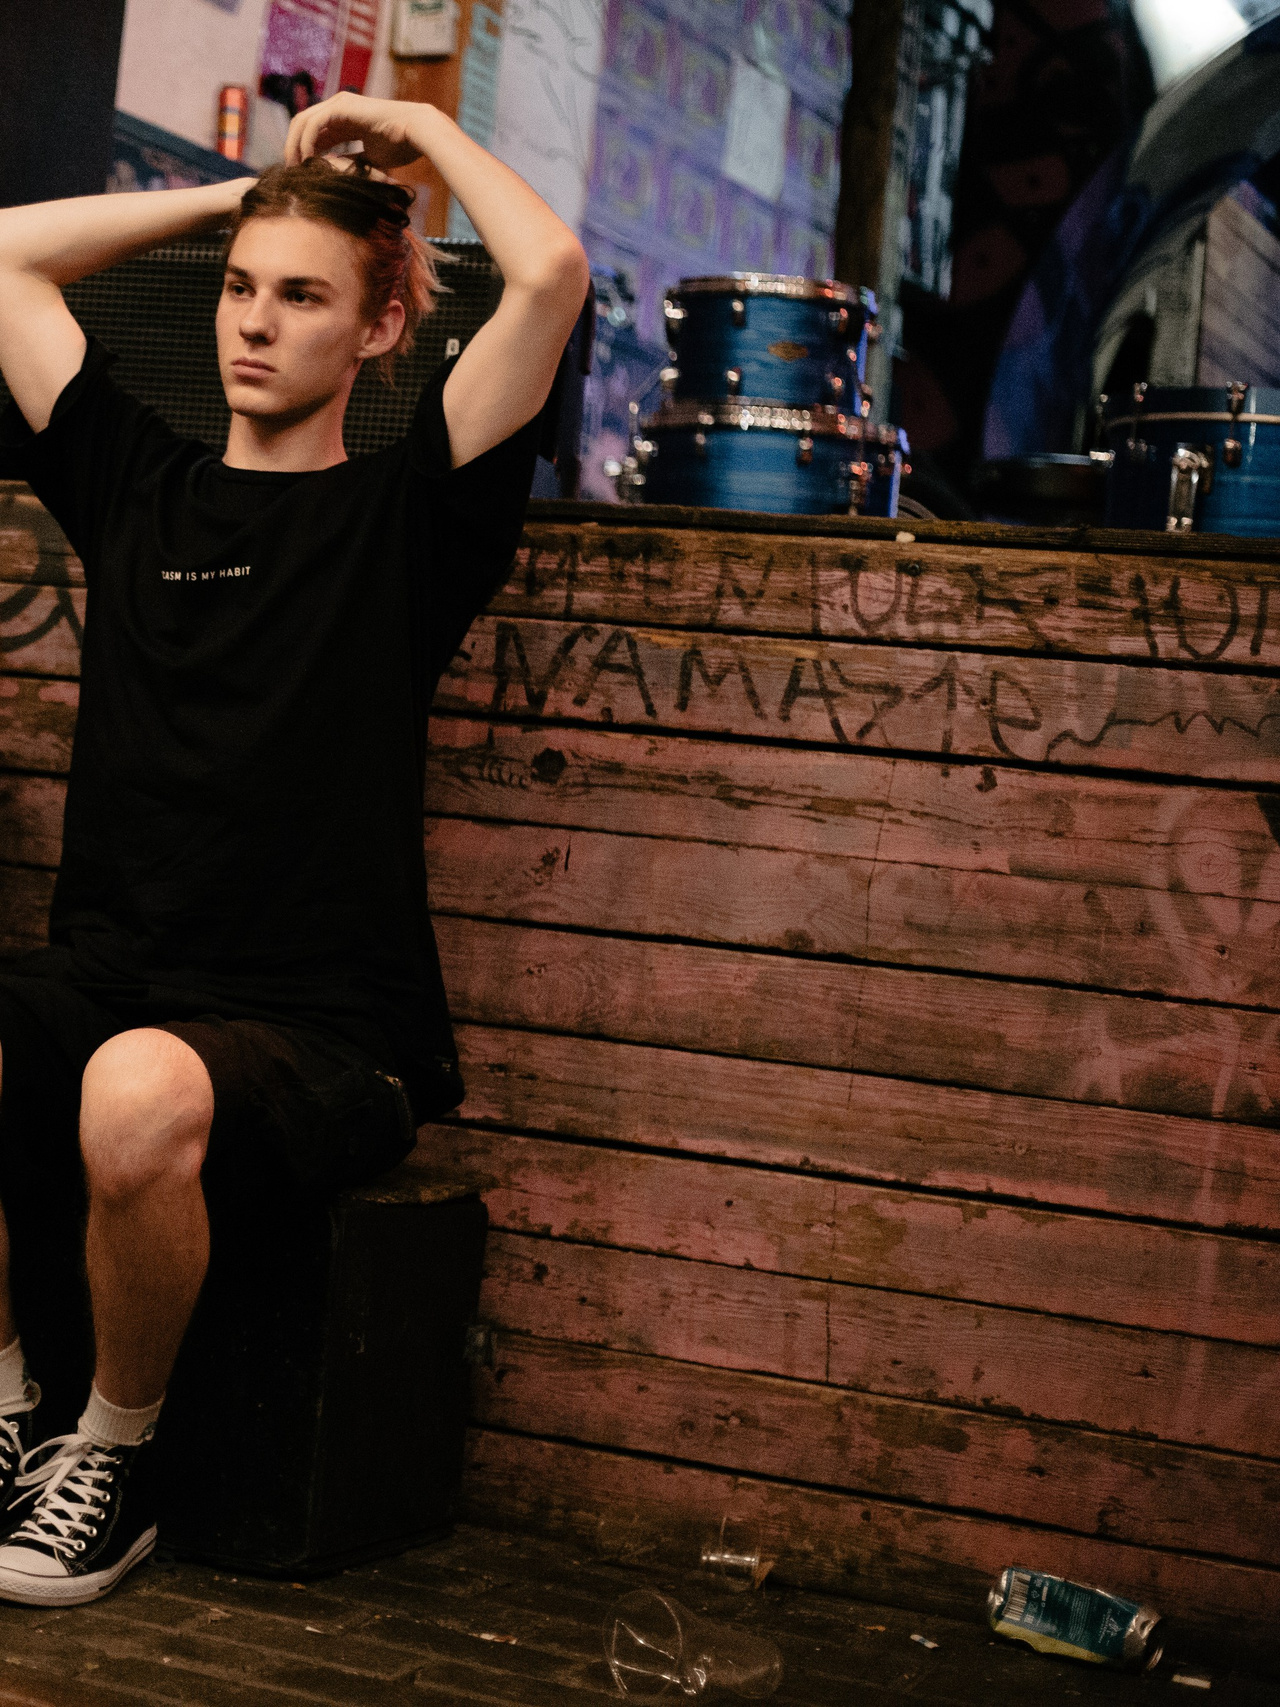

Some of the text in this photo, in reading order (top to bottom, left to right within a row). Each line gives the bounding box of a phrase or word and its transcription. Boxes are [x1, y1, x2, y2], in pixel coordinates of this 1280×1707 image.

[186, 572, 197, 581] IS
[201, 570, 216, 581] MY
[219, 565, 252, 579] HABIT
